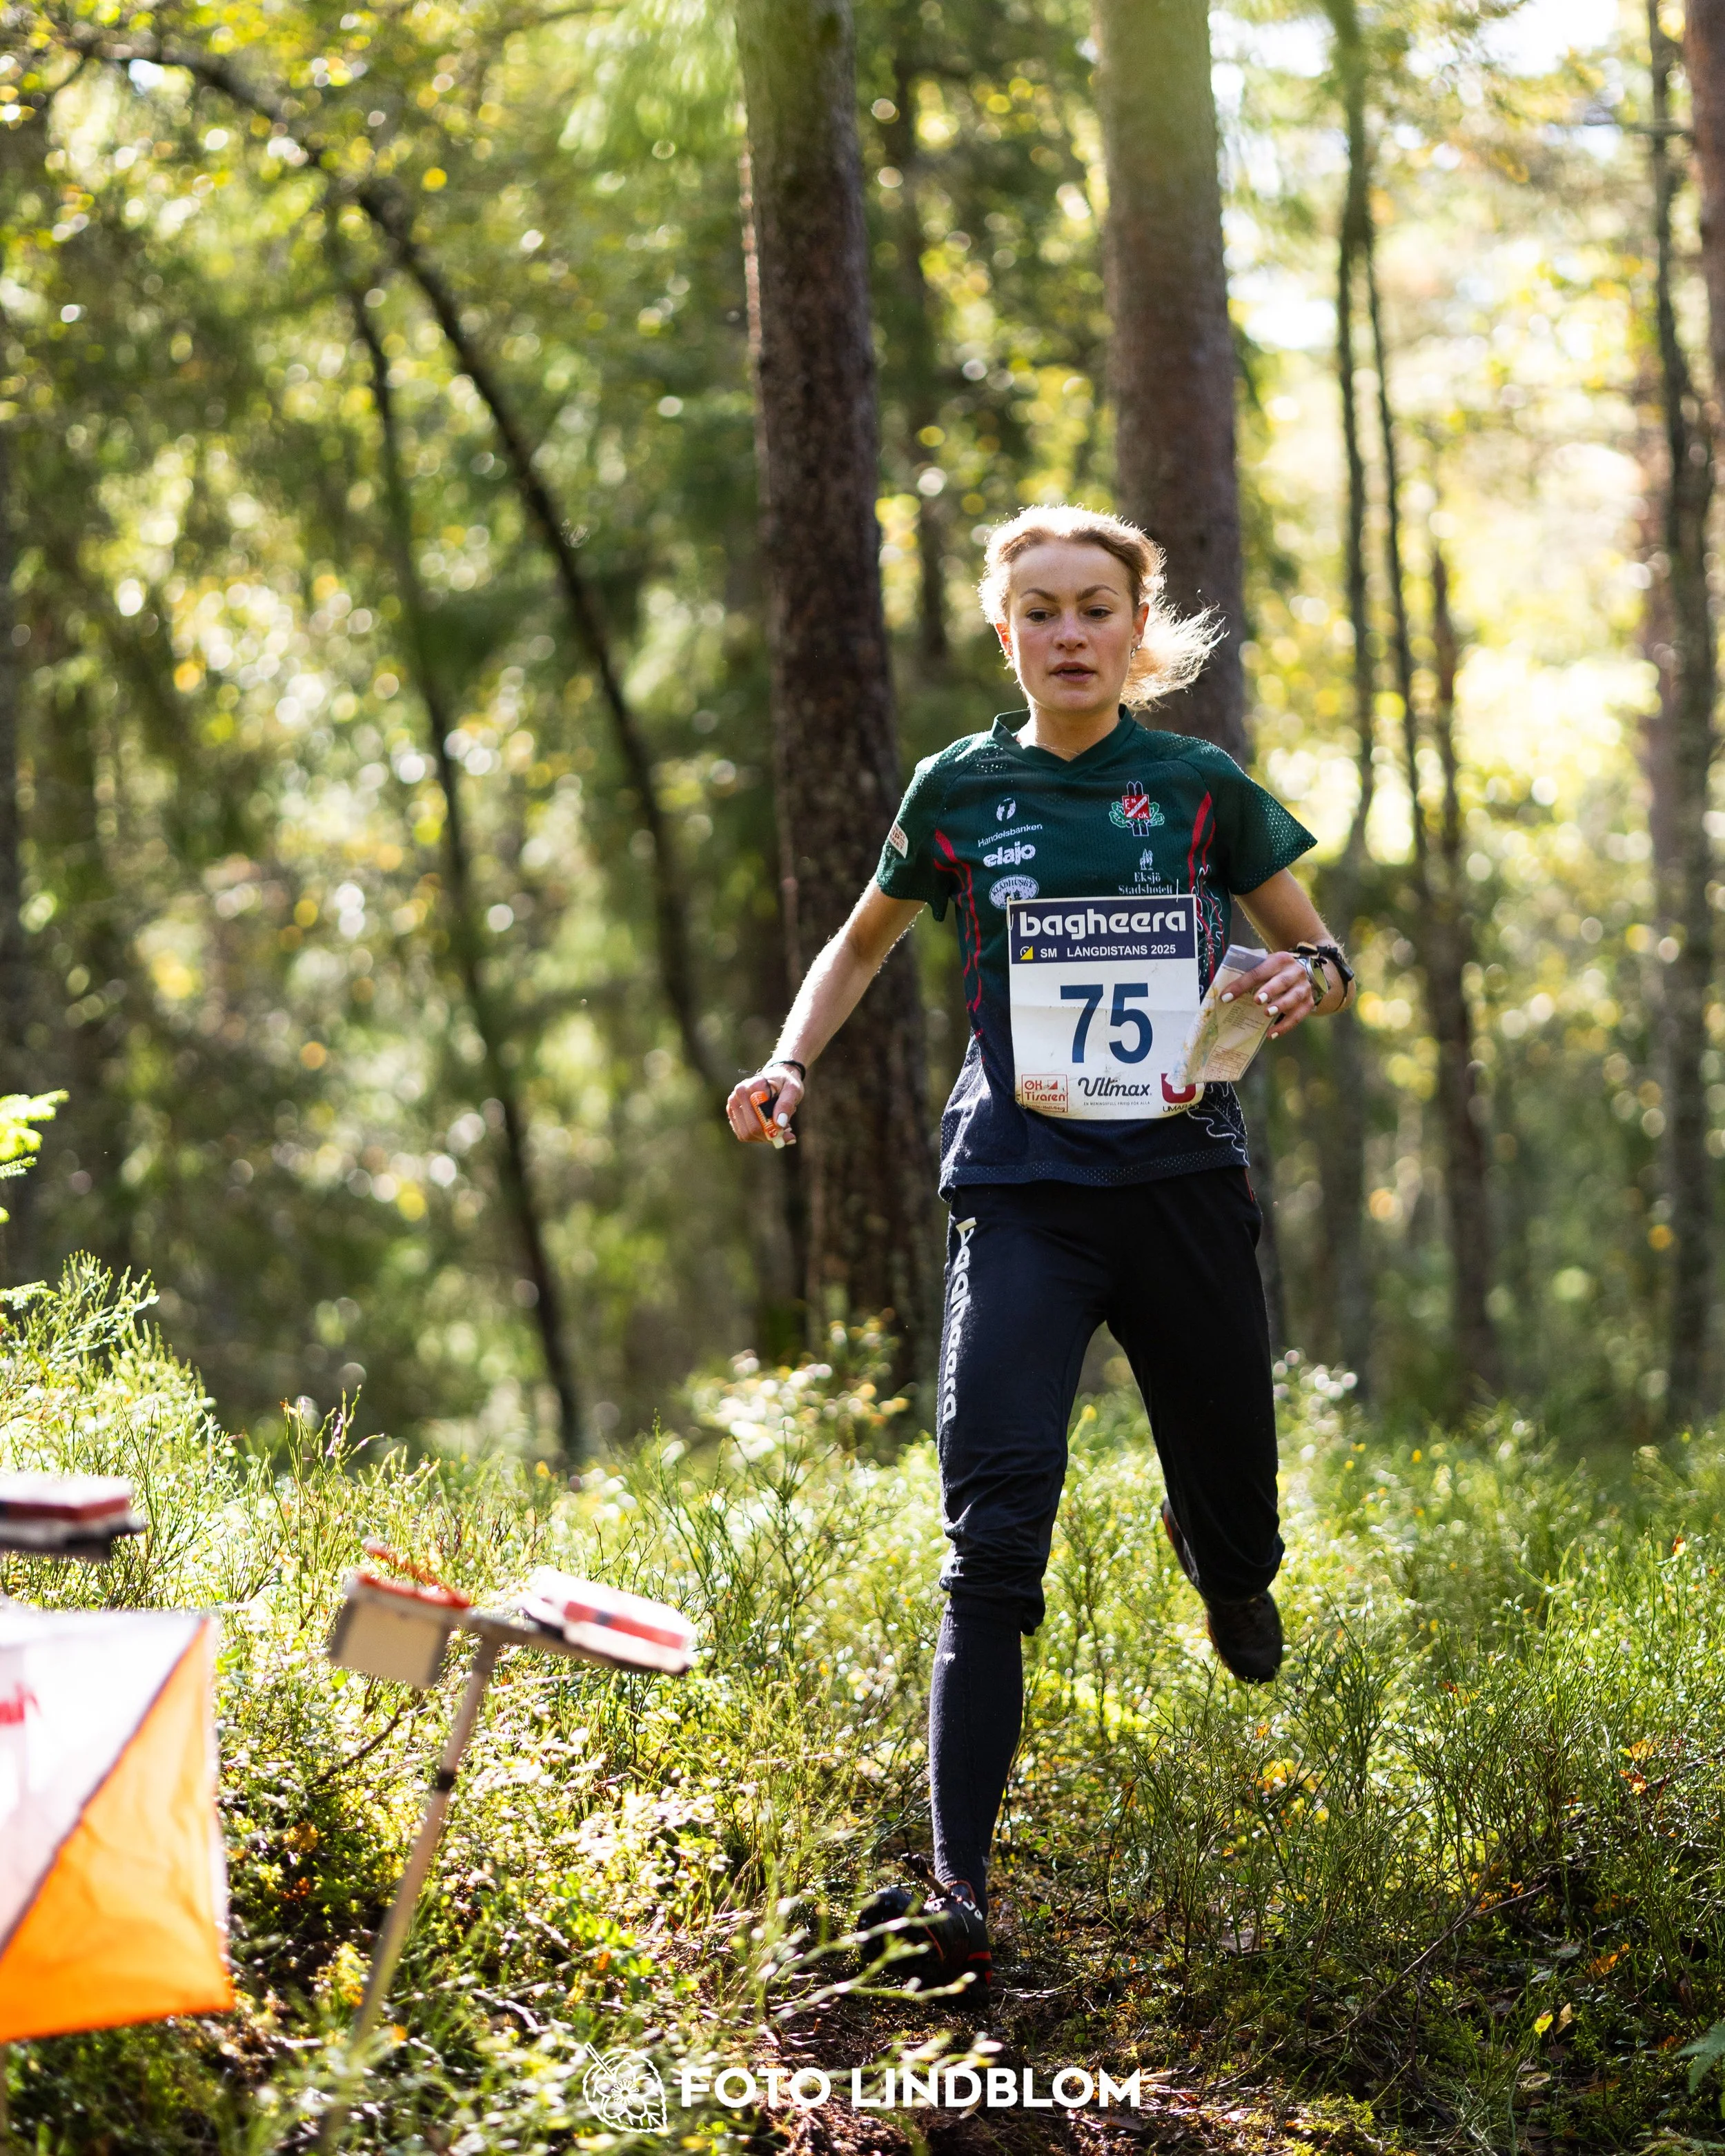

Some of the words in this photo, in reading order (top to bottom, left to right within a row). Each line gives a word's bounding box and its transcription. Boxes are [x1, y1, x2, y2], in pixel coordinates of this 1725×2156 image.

[978, 824, 1043, 847] Handelsbanken
[983, 841, 1036, 867] elajo
[1134, 871, 1161, 884] Eksjö
[1118, 884, 1172, 894] Stadshotell
[1019, 909, 1186, 940] bagheera
[1040, 948, 1057, 958] SM
[1067, 945, 1148, 958] LÅNGDISTANS
[1151, 944, 1176, 955] 2025
[1060, 982, 1153, 1064] 75
[1025, 1091, 1065, 1102] Tisaren
[1078, 1076, 1151, 1097] Ullmax
